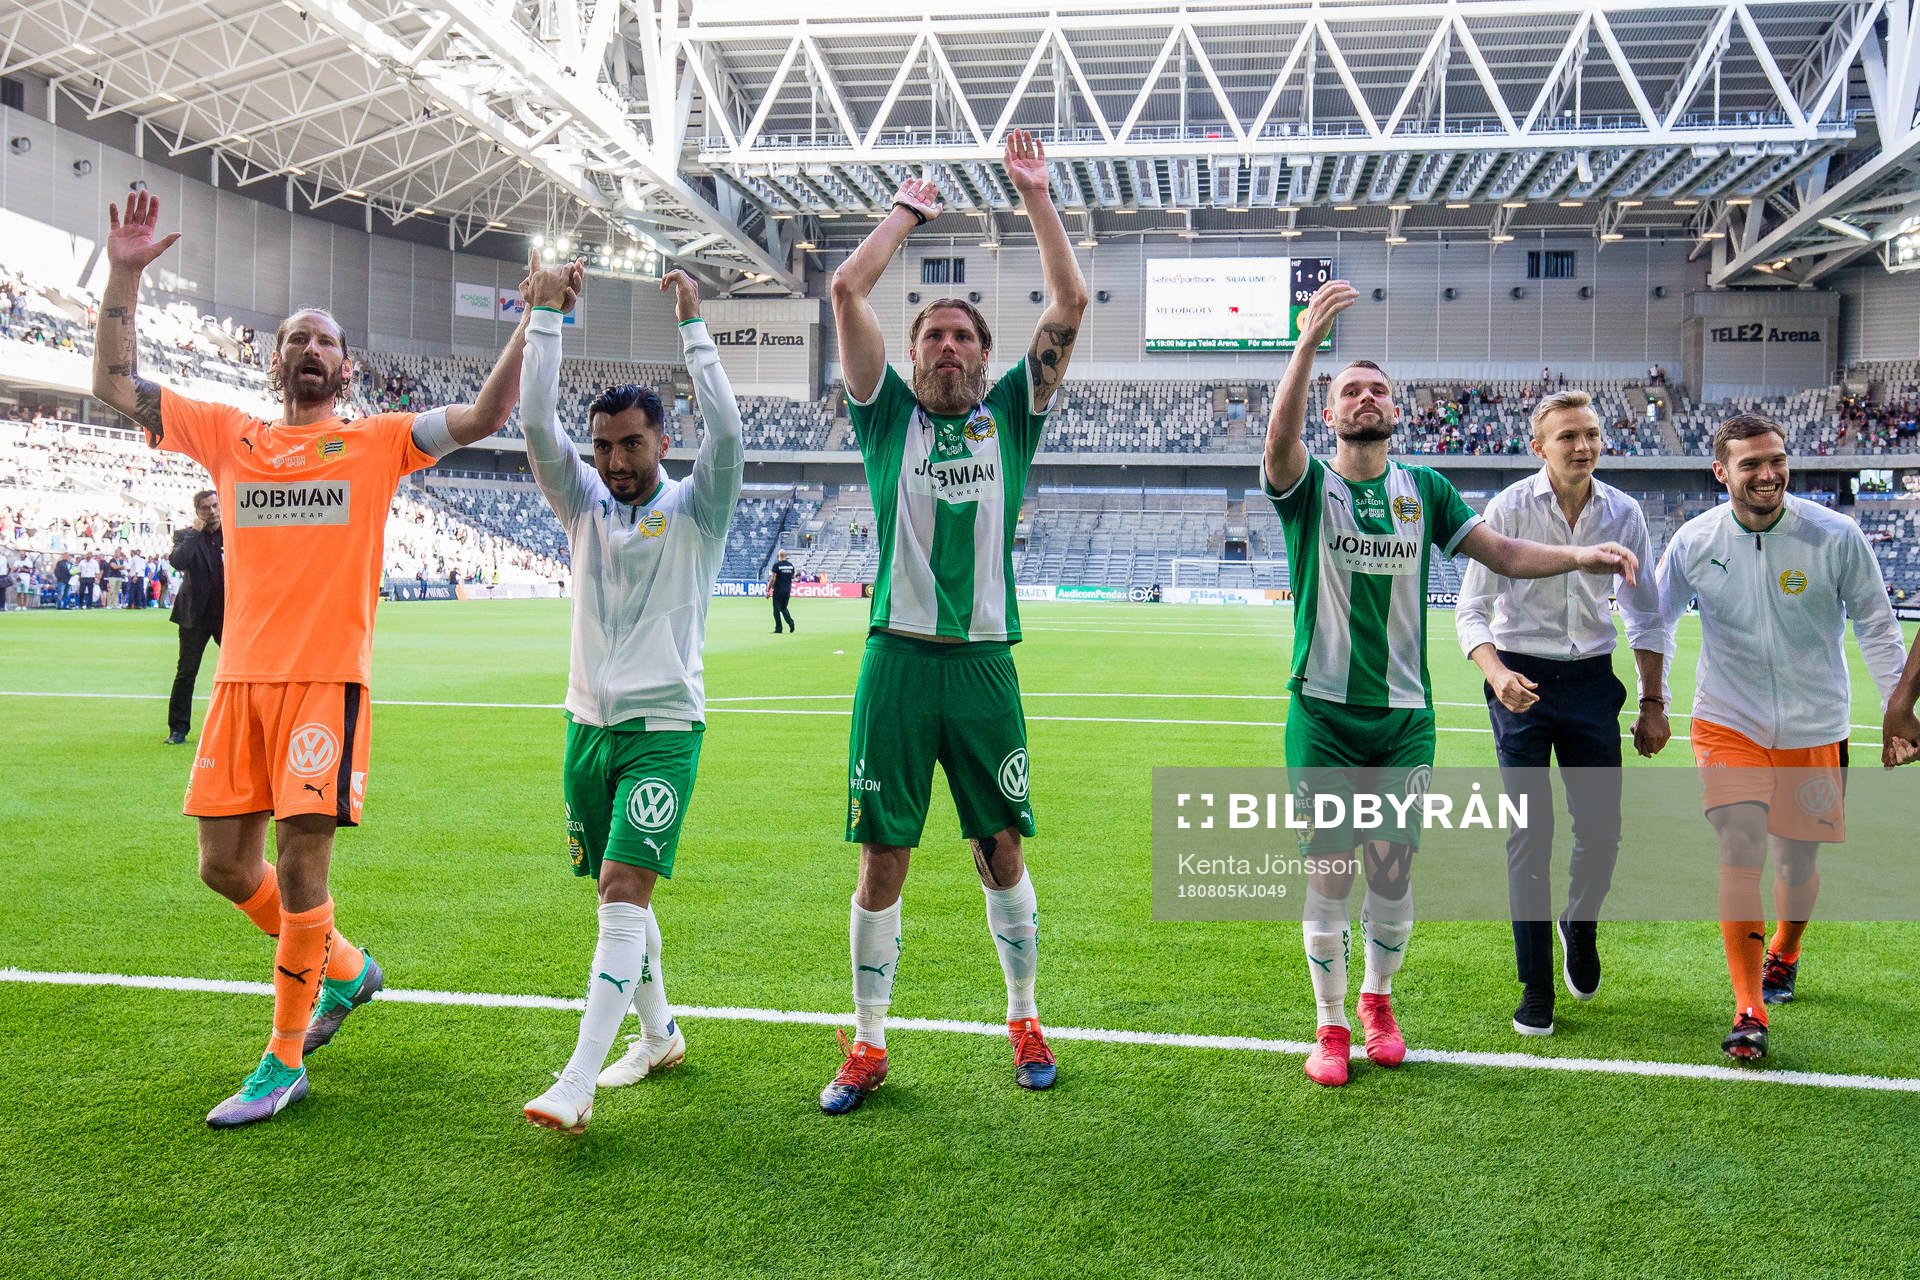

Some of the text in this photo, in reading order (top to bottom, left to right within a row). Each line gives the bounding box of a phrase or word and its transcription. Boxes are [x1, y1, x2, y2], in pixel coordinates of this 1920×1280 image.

[1295, 270, 1302, 283] 1
[1317, 269, 1327, 283] 0
[712, 327, 805, 346] TELE2 Arena
[1710, 323, 1821, 342] TELE2 Arena
[240, 488, 344, 509] JOBMAN
[257, 512, 324, 520] WORKWEAR
[1328, 535, 1417, 559] JOBMAN
[1345, 558, 1404, 569] WORKWEAR
[713, 583, 767, 596] ENTRAL BAR
[790, 581, 841, 597] Scandic
